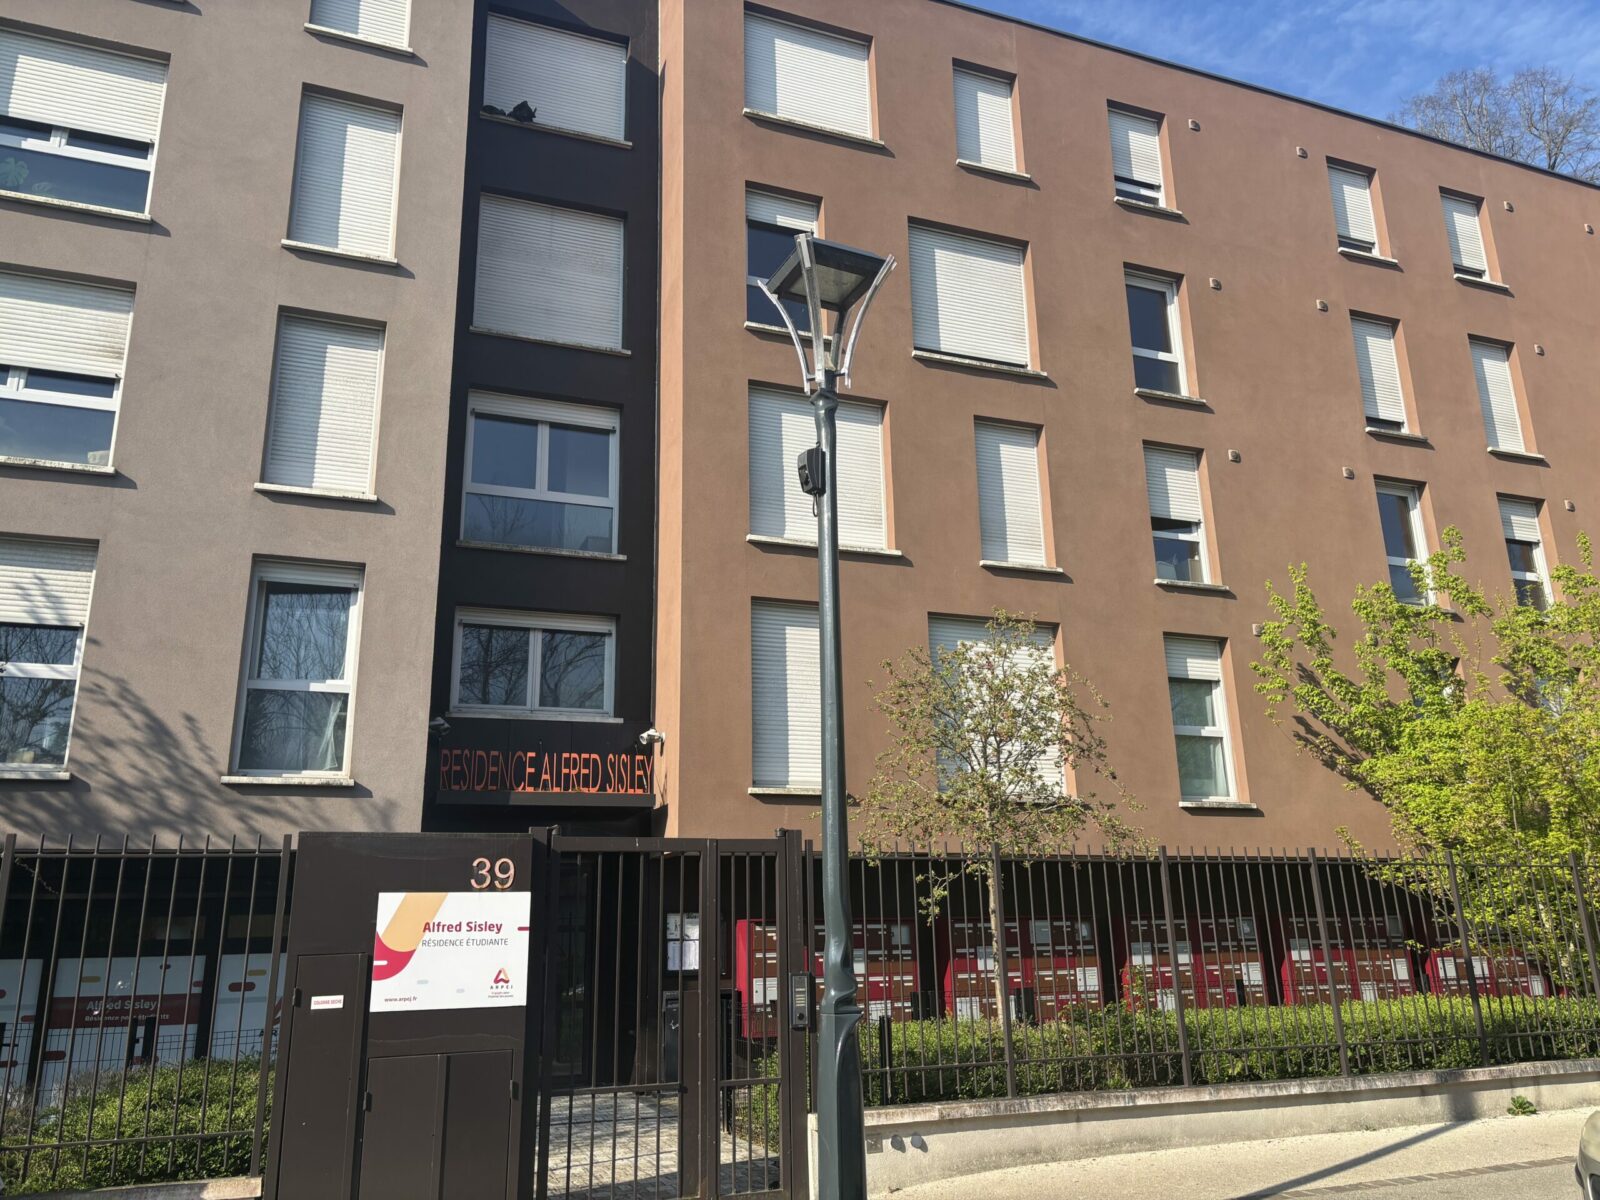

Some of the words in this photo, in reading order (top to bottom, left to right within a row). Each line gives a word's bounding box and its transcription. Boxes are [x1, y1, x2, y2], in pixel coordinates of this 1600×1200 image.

[439, 750, 536, 792] RESIDENCE
[539, 752, 602, 793] ALFRED
[606, 753, 653, 794] SISLEY
[470, 857, 515, 889] 39
[422, 921, 462, 933] Alfred
[466, 921, 503, 934] Sisley
[421, 938, 464, 948] RÉSIDENCE
[466, 936, 509, 947] ÉTUDIANTE
